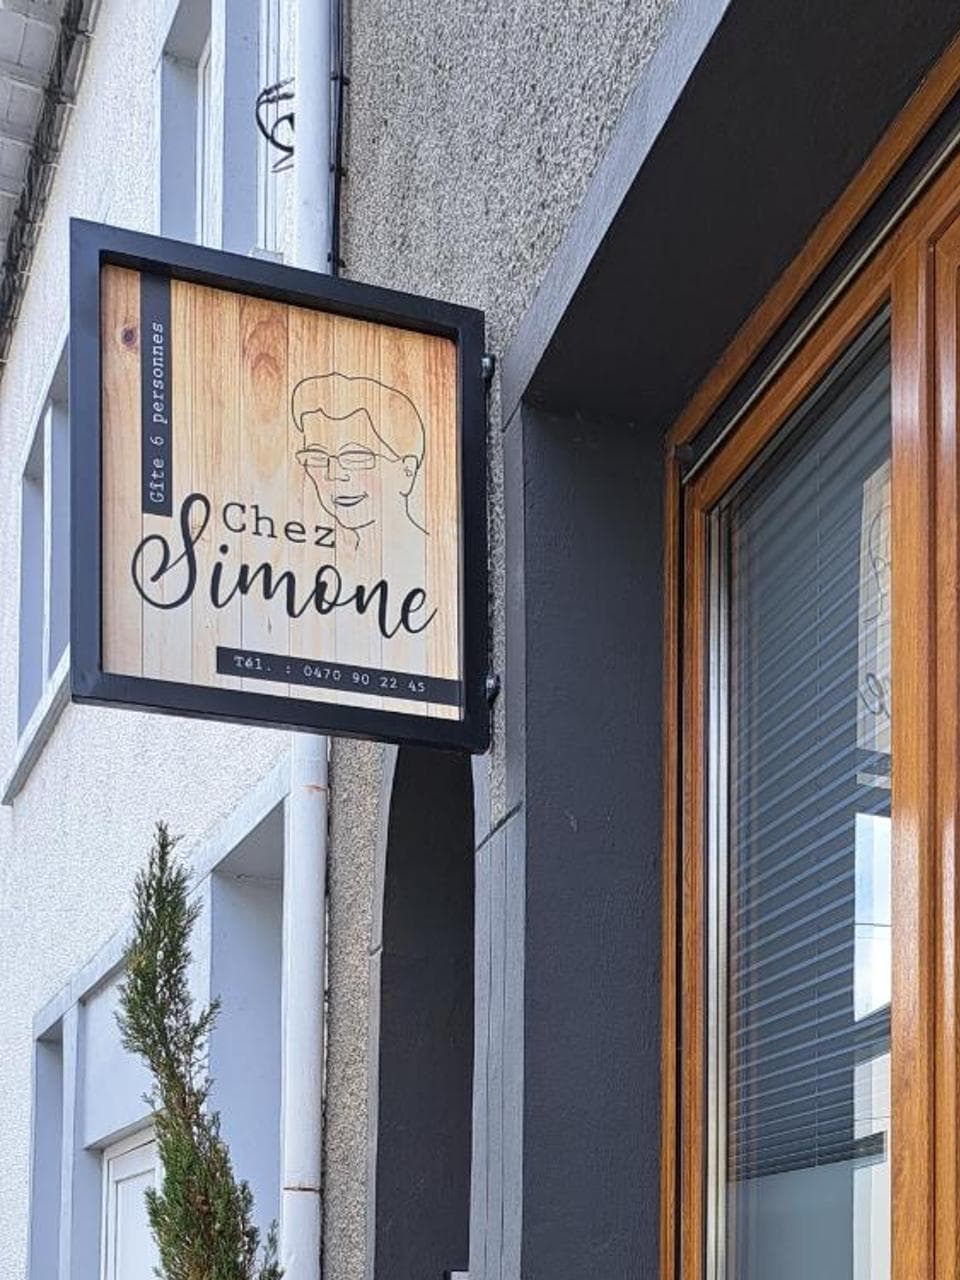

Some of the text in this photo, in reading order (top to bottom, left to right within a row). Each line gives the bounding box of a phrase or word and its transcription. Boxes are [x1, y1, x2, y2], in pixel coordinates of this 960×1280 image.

[152, 322, 168, 424] personnes
[150, 435, 165, 446] 6
[222, 502, 336, 549] Chez
[131, 492, 438, 639] Simone
[303, 663, 342, 681] 0470
[352, 671, 370, 686] 90
[379, 676, 398, 689] 22
[407, 680, 425, 693] 45
